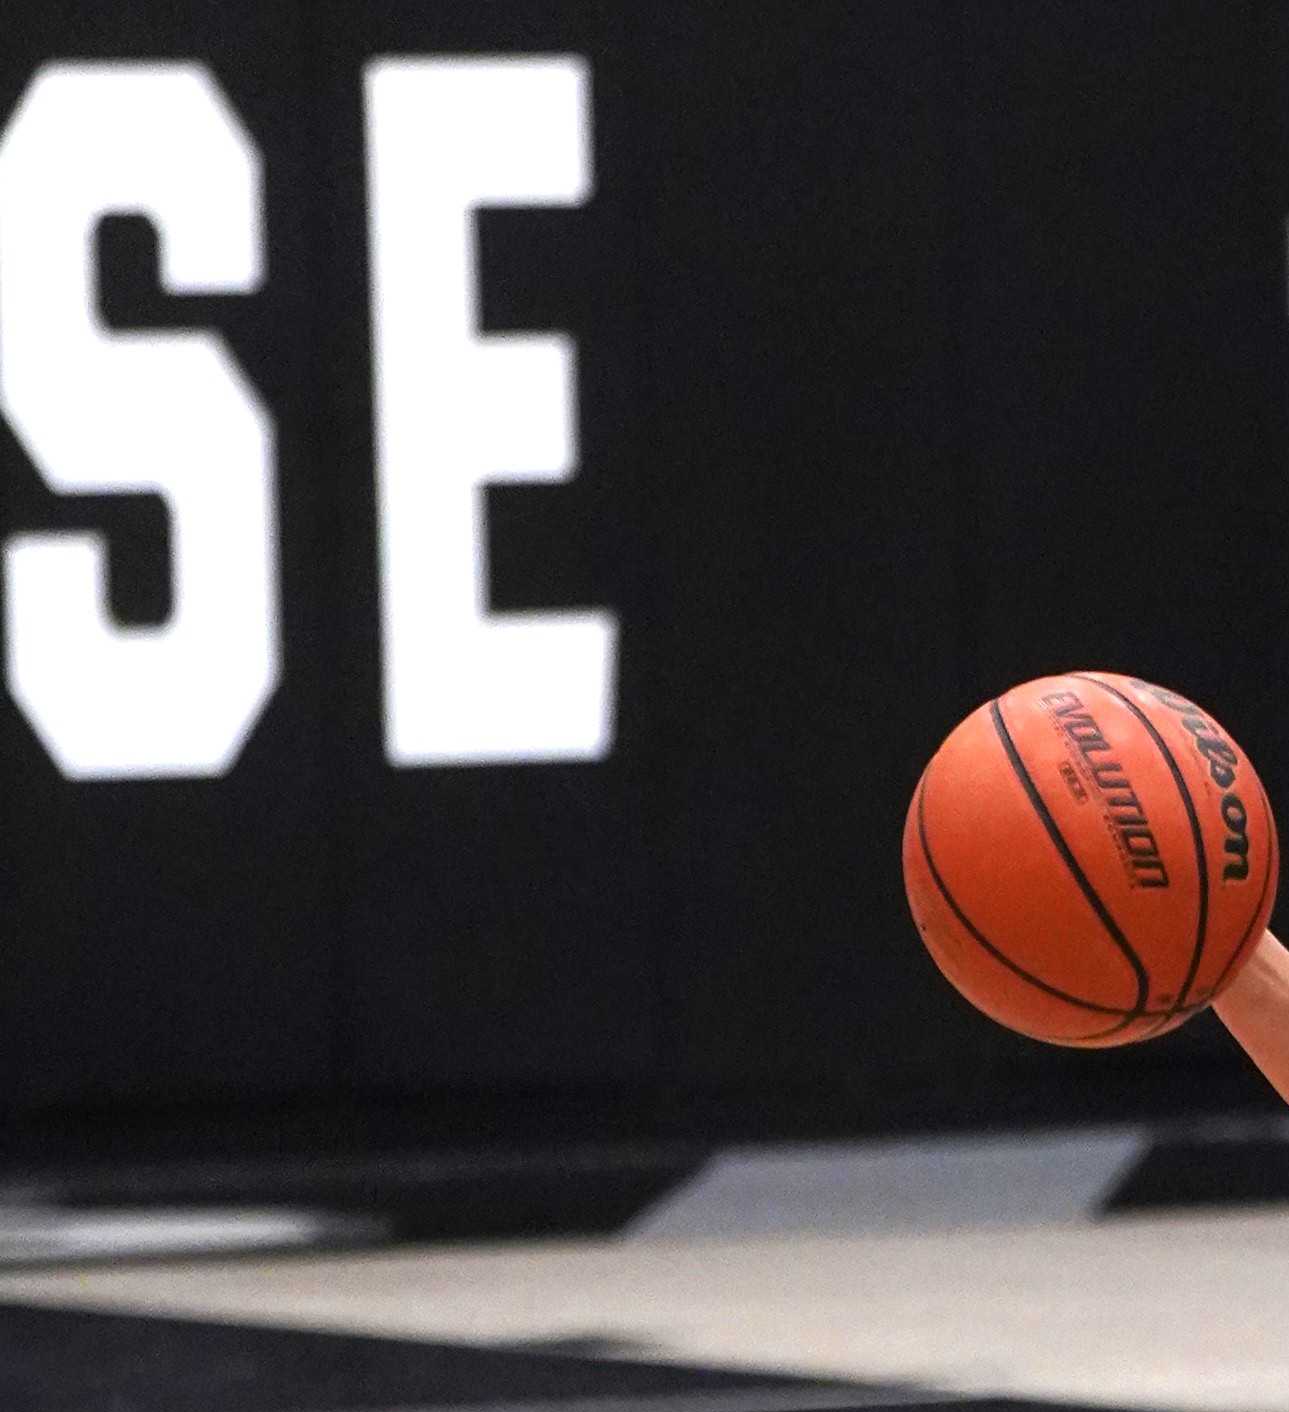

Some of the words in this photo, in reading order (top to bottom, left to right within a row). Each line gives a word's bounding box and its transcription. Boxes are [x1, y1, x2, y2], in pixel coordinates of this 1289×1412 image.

[0, 55, 617, 780] SE
[1040, 692, 1170, 889] EVOLUTION
[1129, 678, 1249, 881] Wilson
